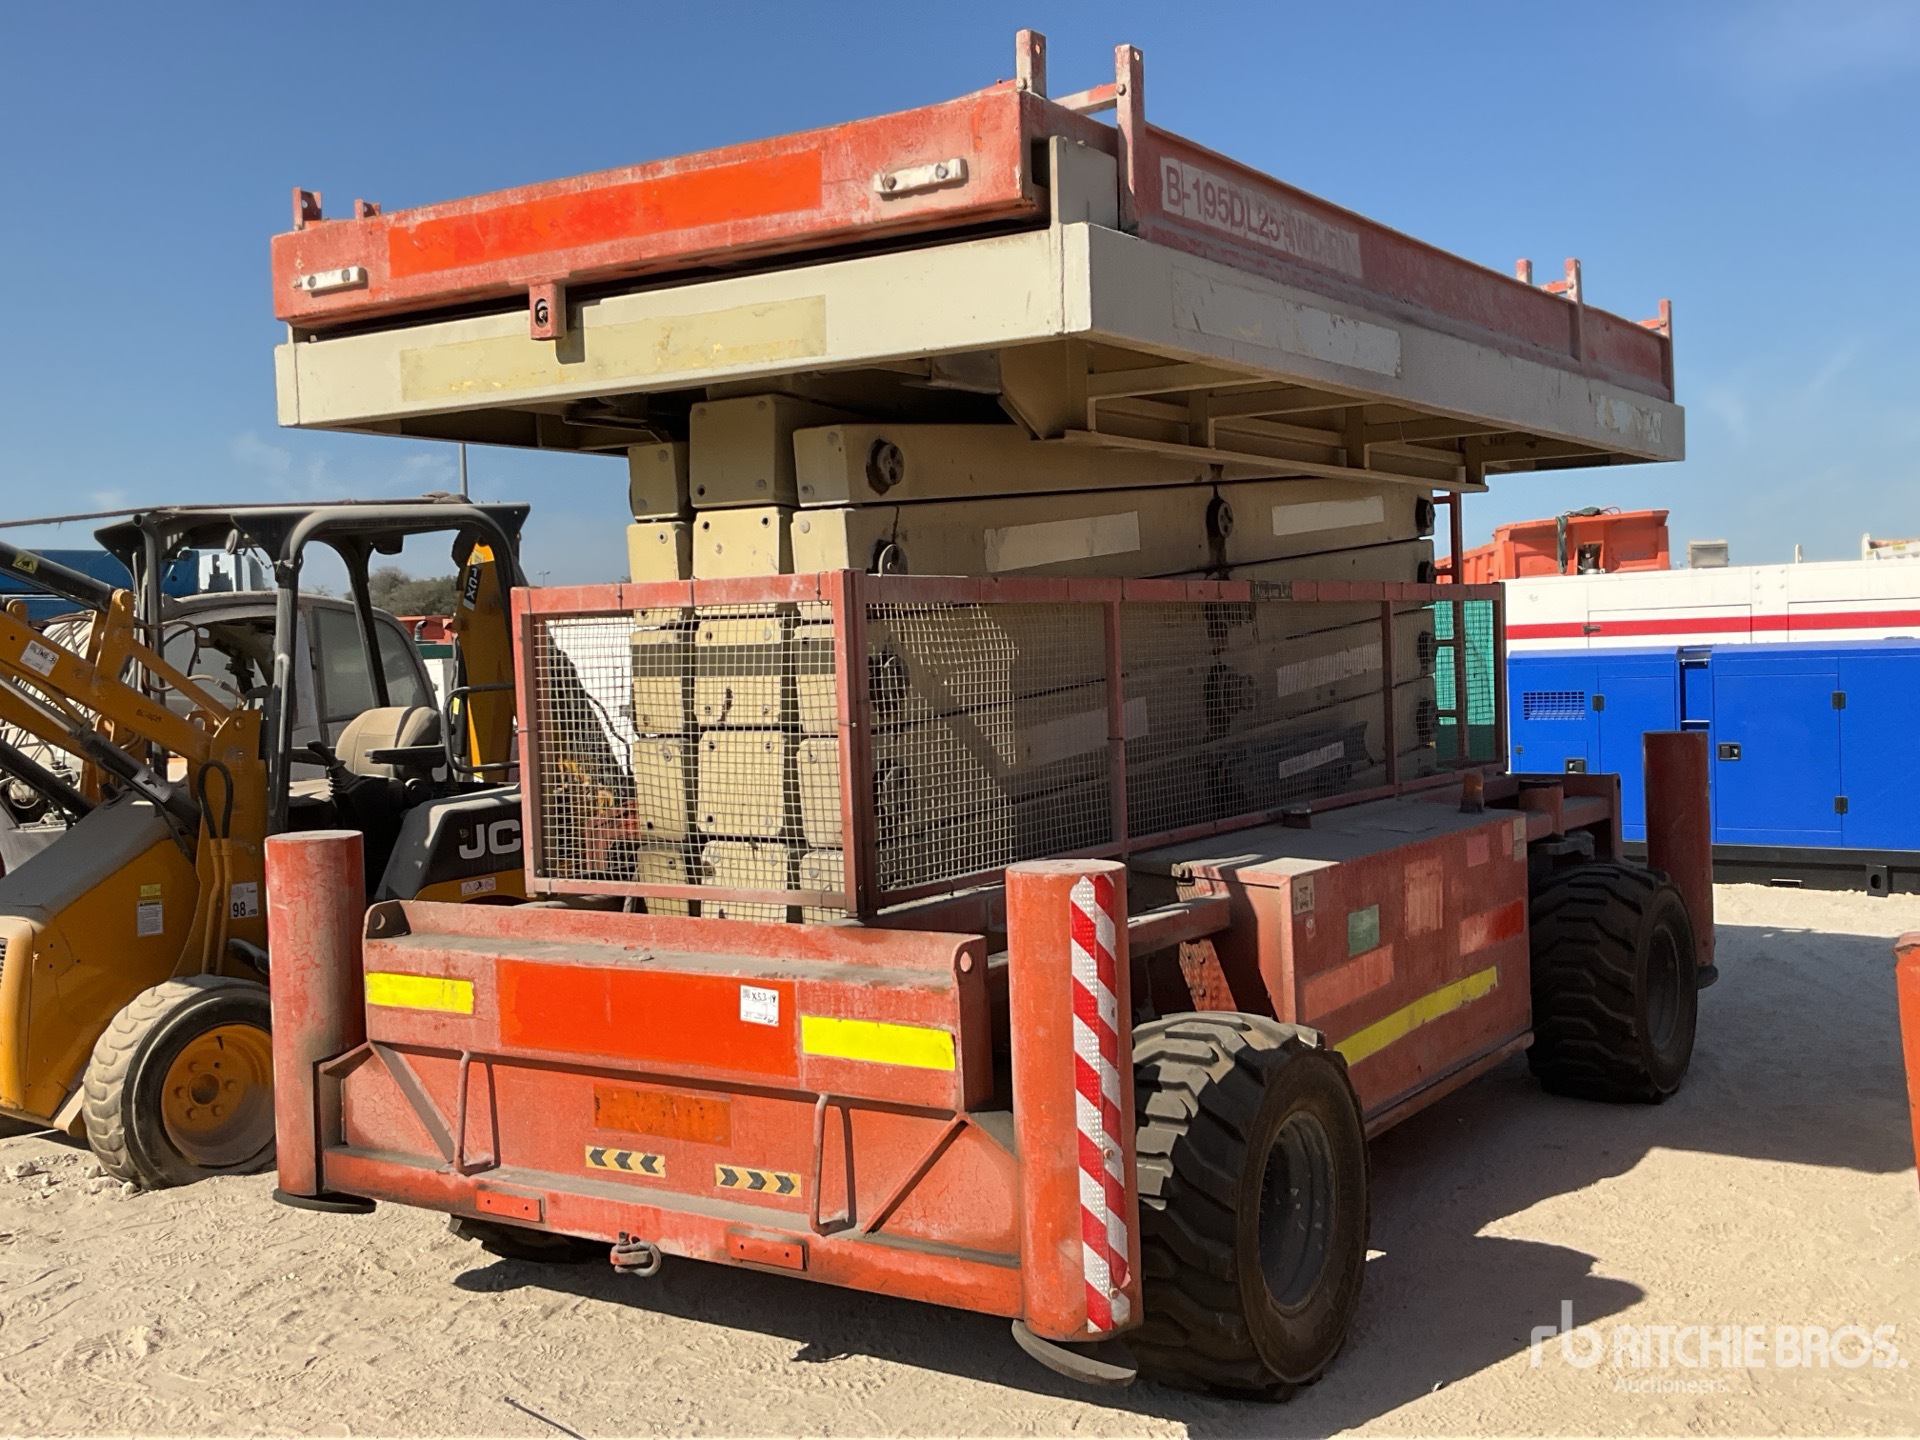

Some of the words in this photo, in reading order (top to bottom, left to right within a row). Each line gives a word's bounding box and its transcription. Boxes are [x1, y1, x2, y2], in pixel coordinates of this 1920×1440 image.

[1165, 165, 1281, 243] B-195DL25
[459, 819, 521, 859] JC
[232, 901, 246, 917] 98
